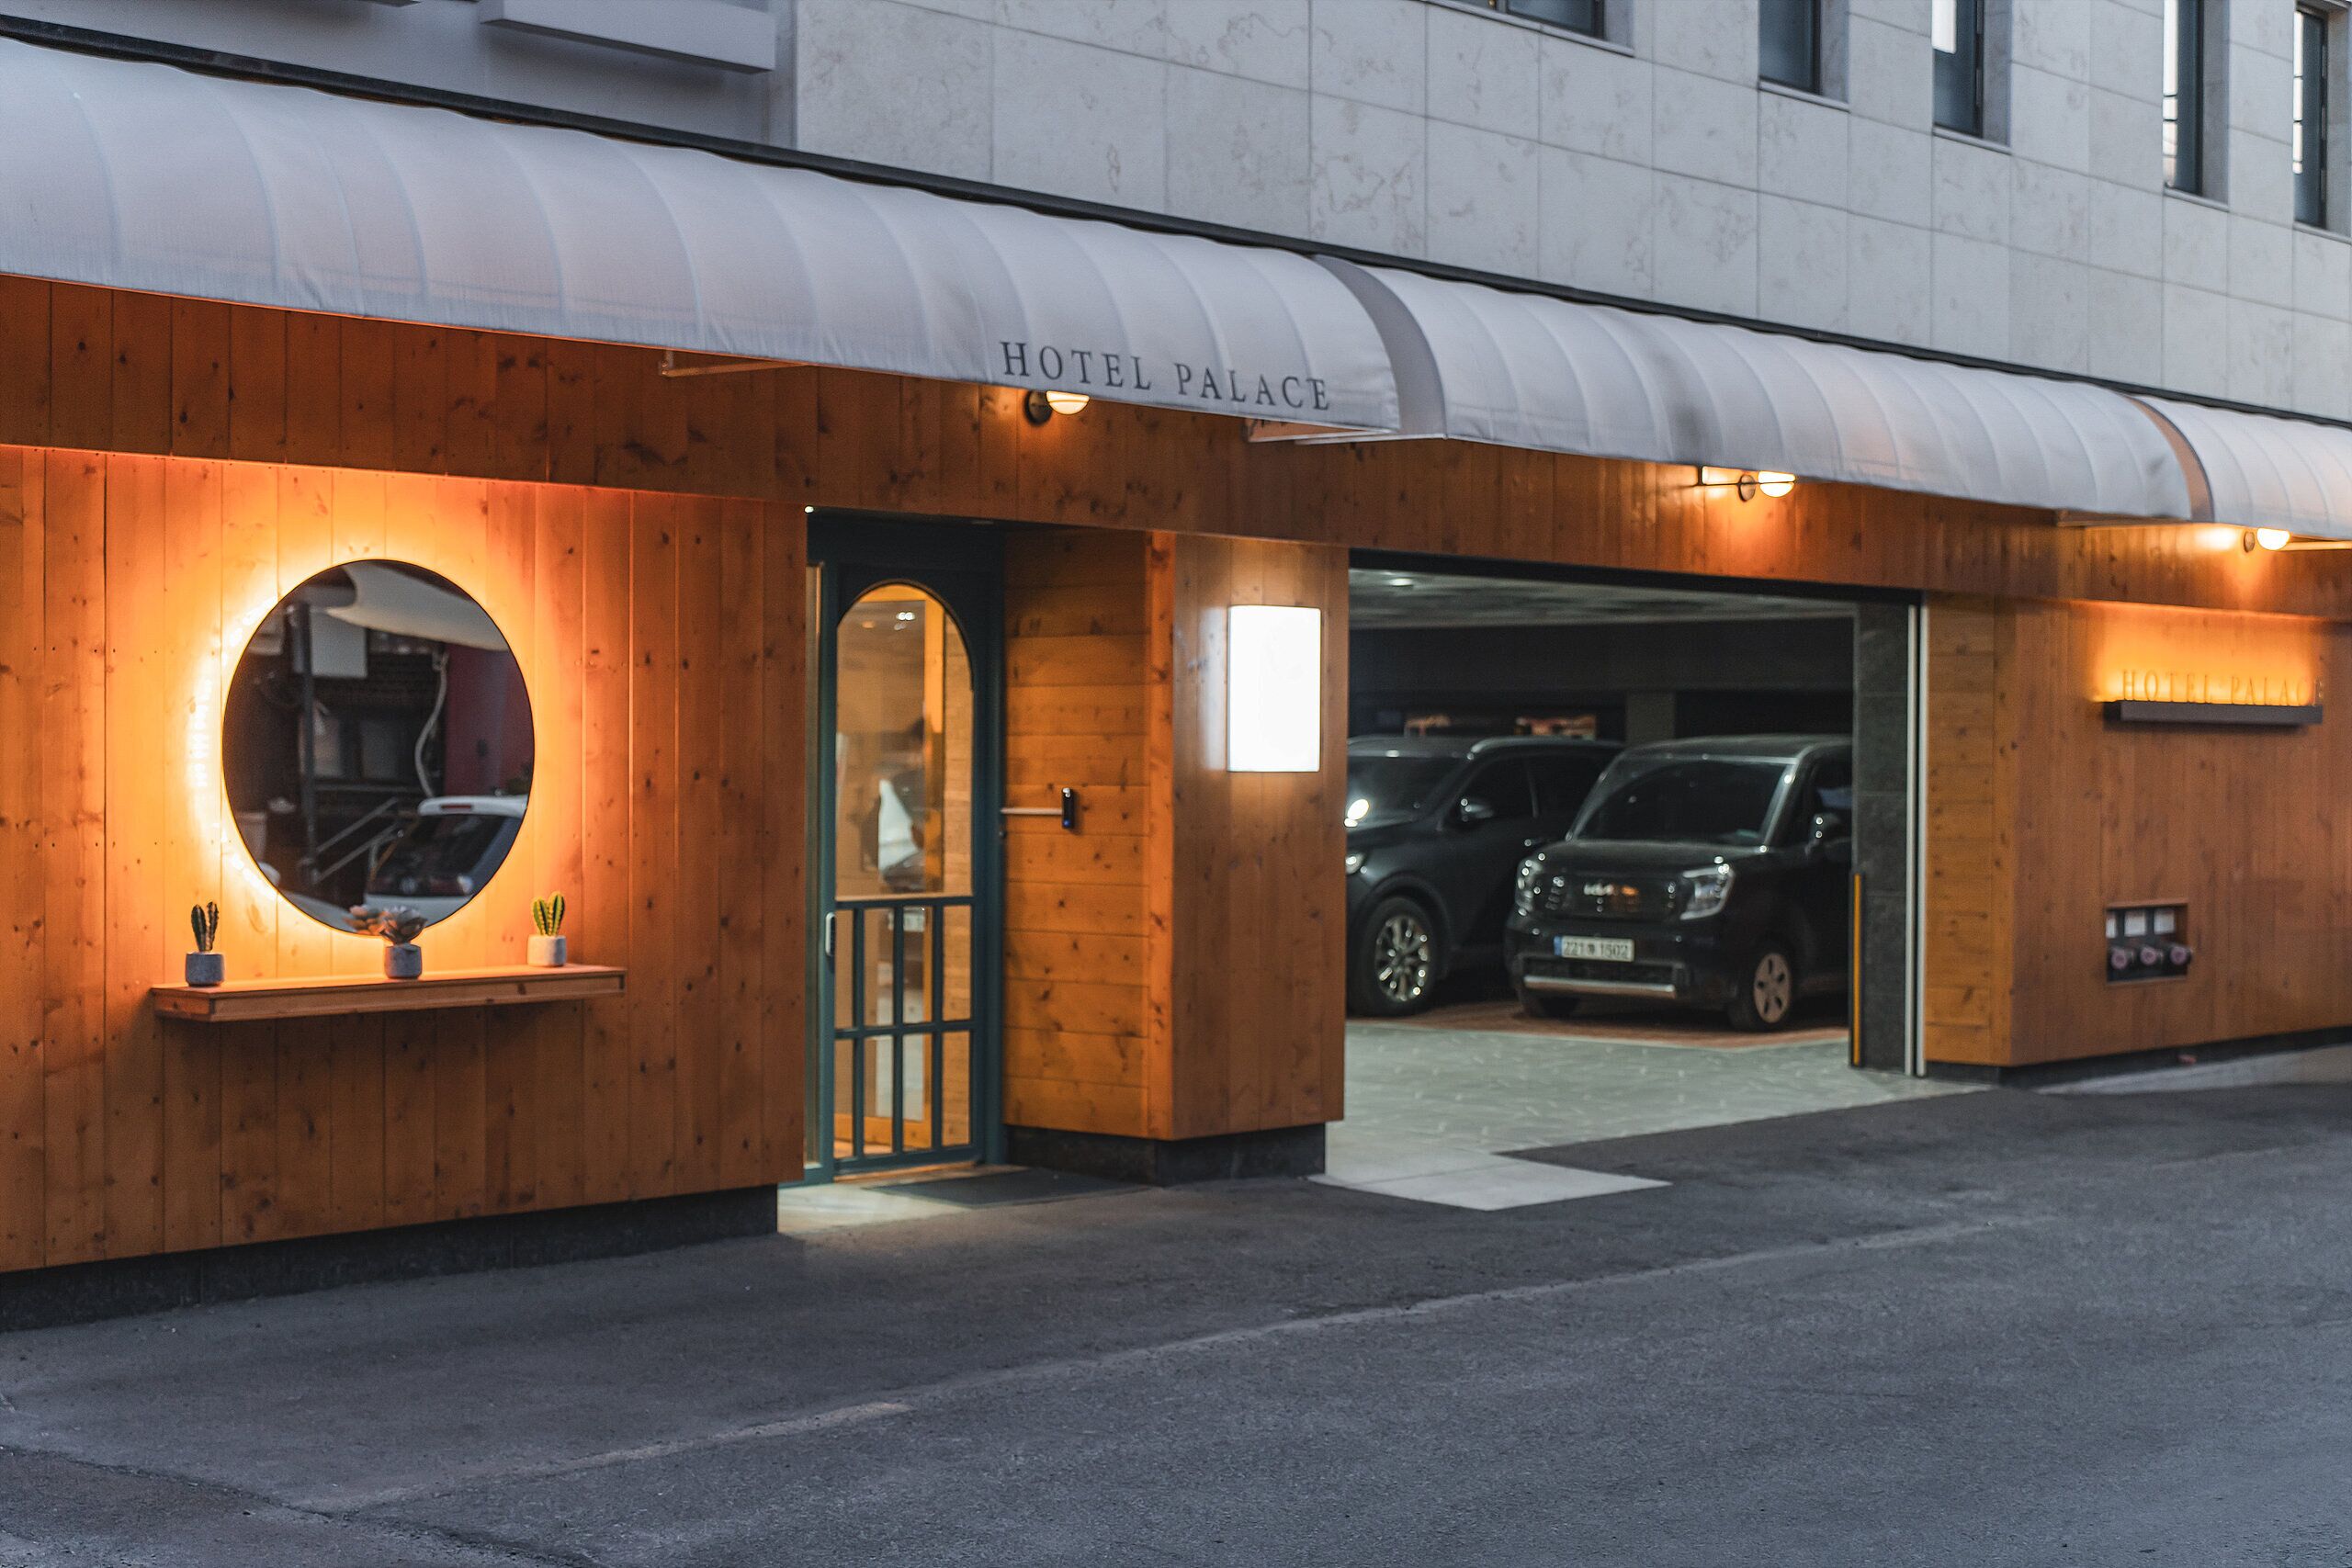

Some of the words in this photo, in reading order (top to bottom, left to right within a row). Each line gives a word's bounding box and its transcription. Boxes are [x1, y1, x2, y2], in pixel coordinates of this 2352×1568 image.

[1001, 341, 1151, 390] HOTEL
[1174, 363, 1330, 411] PALACE
[2121, 669, 2214, 703] HOTEL
